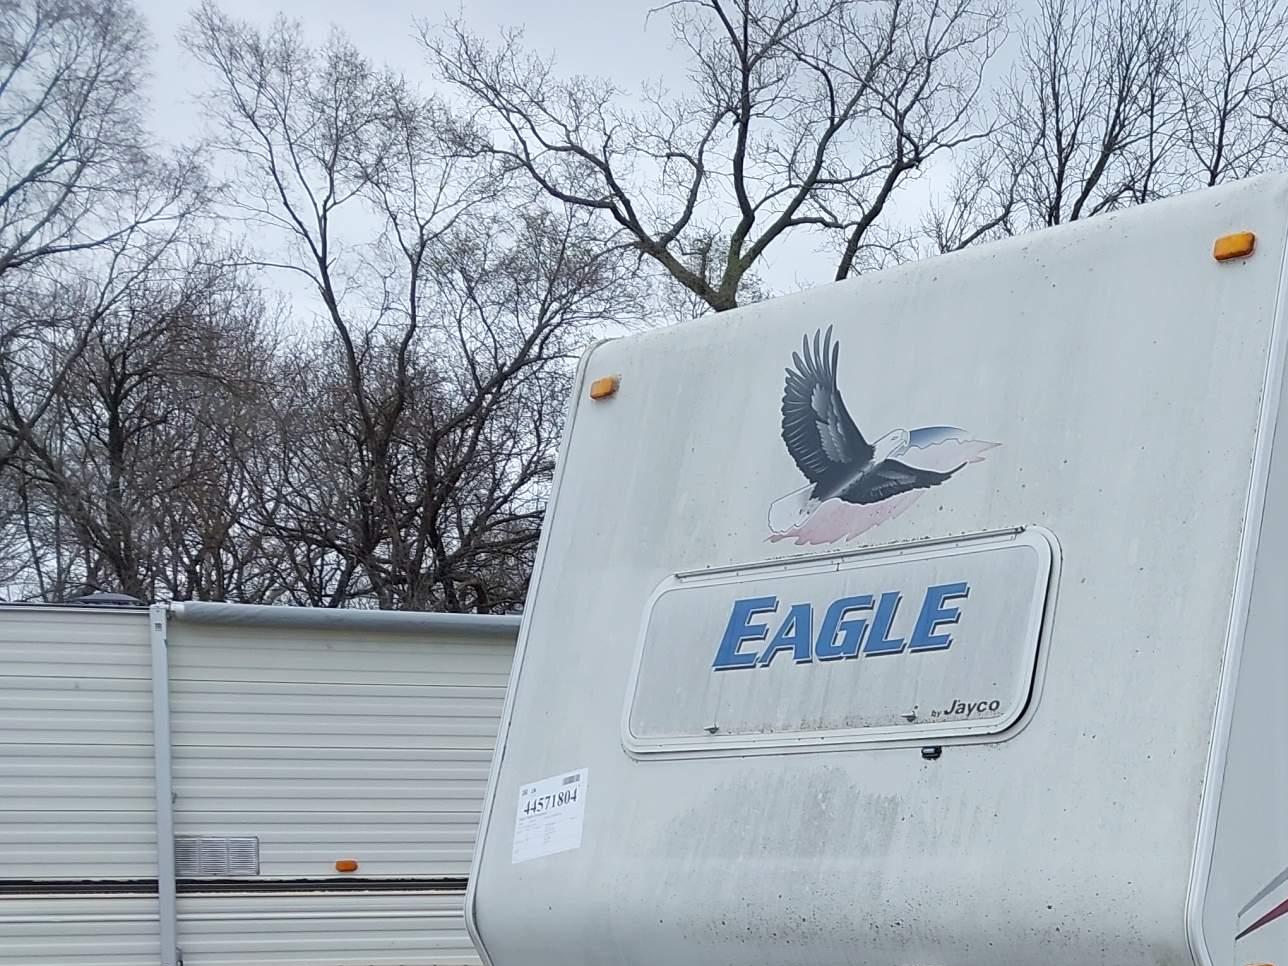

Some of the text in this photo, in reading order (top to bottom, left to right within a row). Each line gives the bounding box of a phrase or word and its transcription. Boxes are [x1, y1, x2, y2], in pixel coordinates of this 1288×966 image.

[712, 581, 970, 672] EAGLE
[944, 699, 1001, 718] Jayco
[523, 787, 578, 816] 44571804
